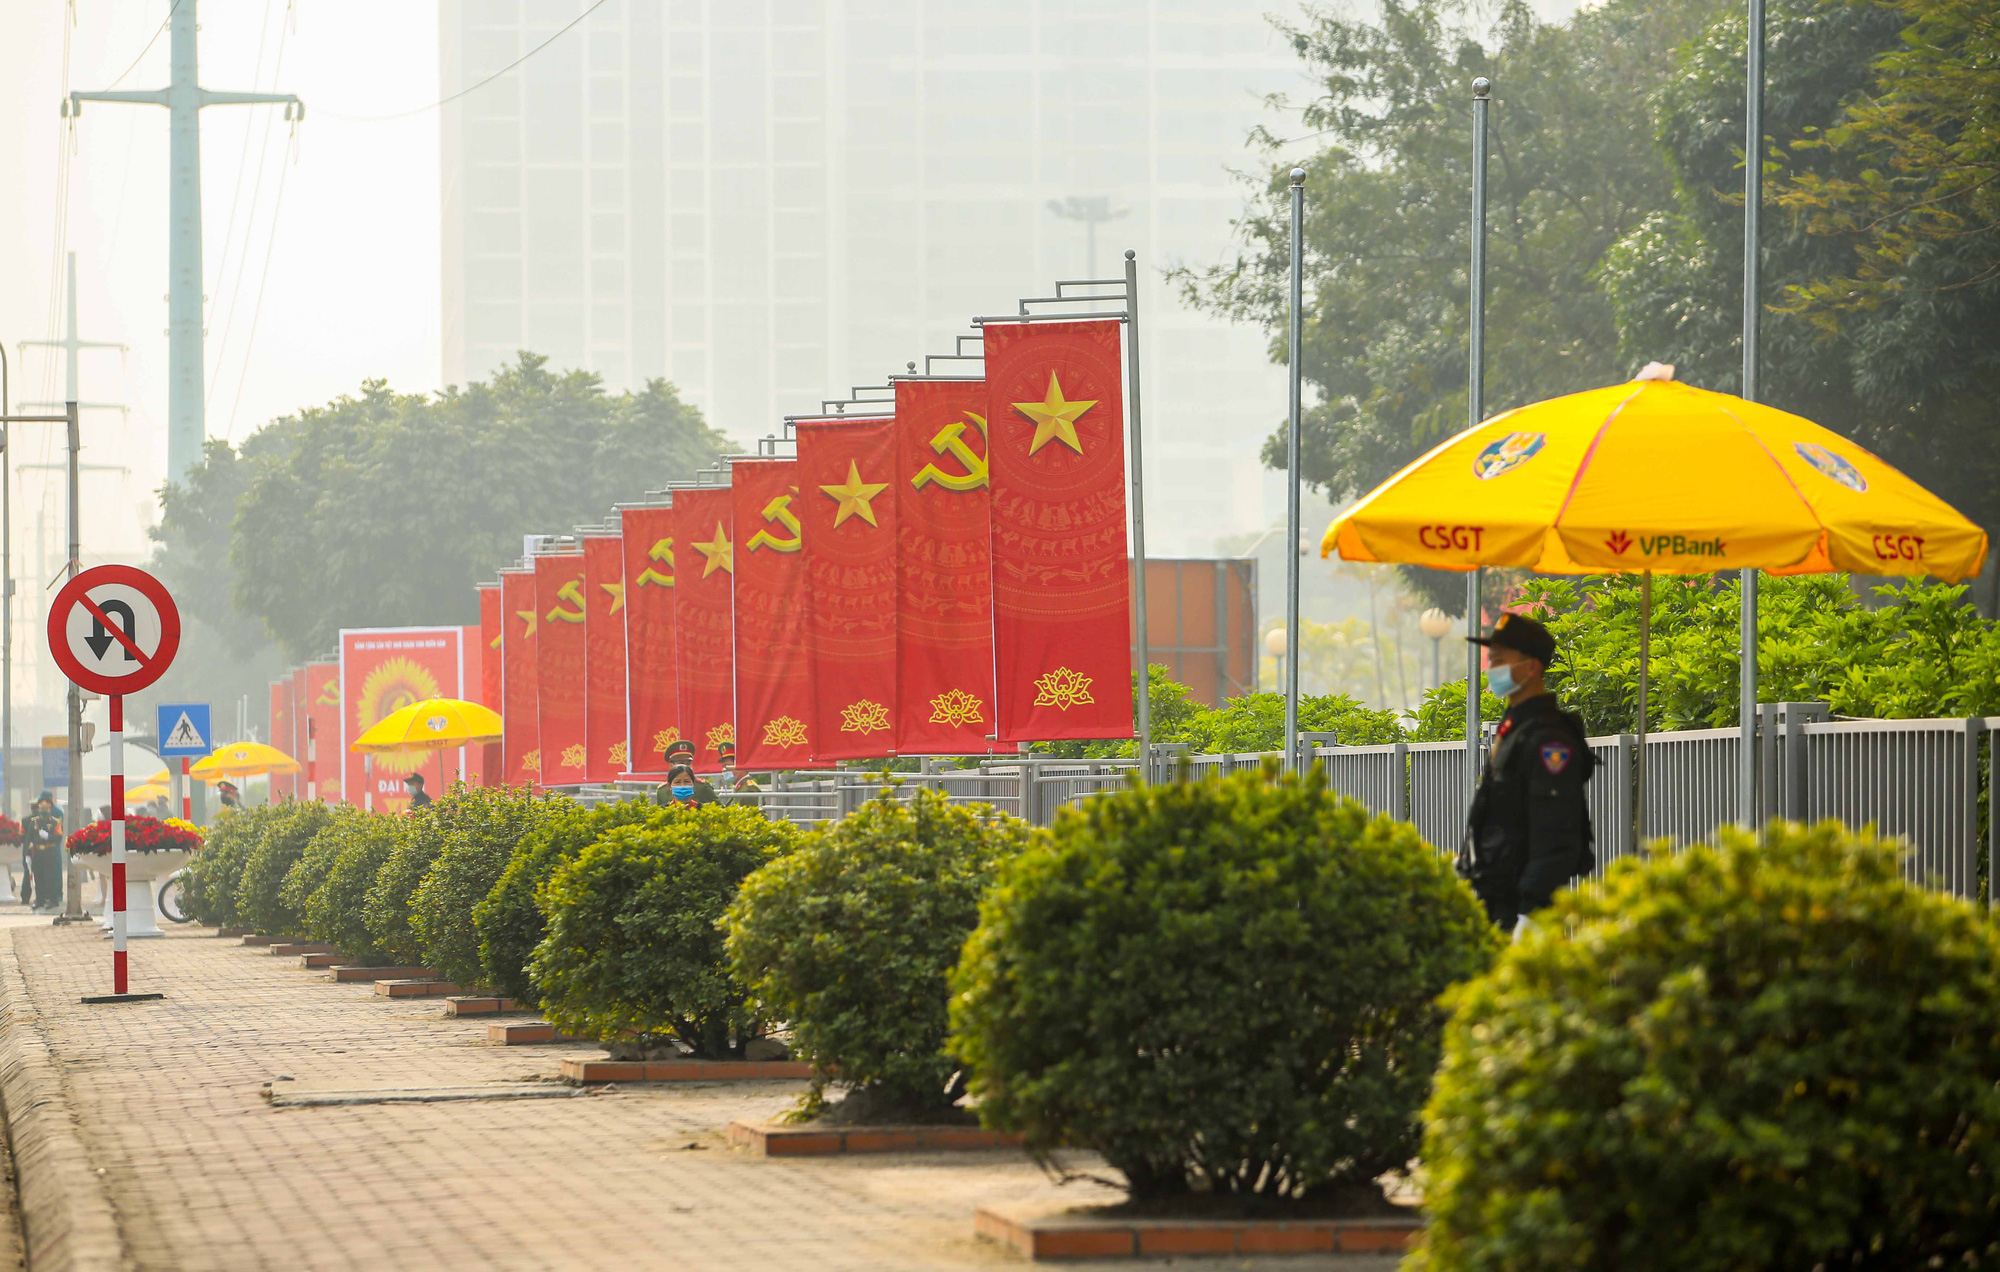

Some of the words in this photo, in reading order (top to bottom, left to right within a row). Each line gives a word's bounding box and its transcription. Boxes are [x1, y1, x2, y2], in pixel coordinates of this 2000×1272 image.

[1419, 525, 1484, 552] CSGT
[1640, 535, 1727, 557] VPBank
[1873, 534, 1925, 560] CSGT
[378, 779, 399, 796] ĐẠI
